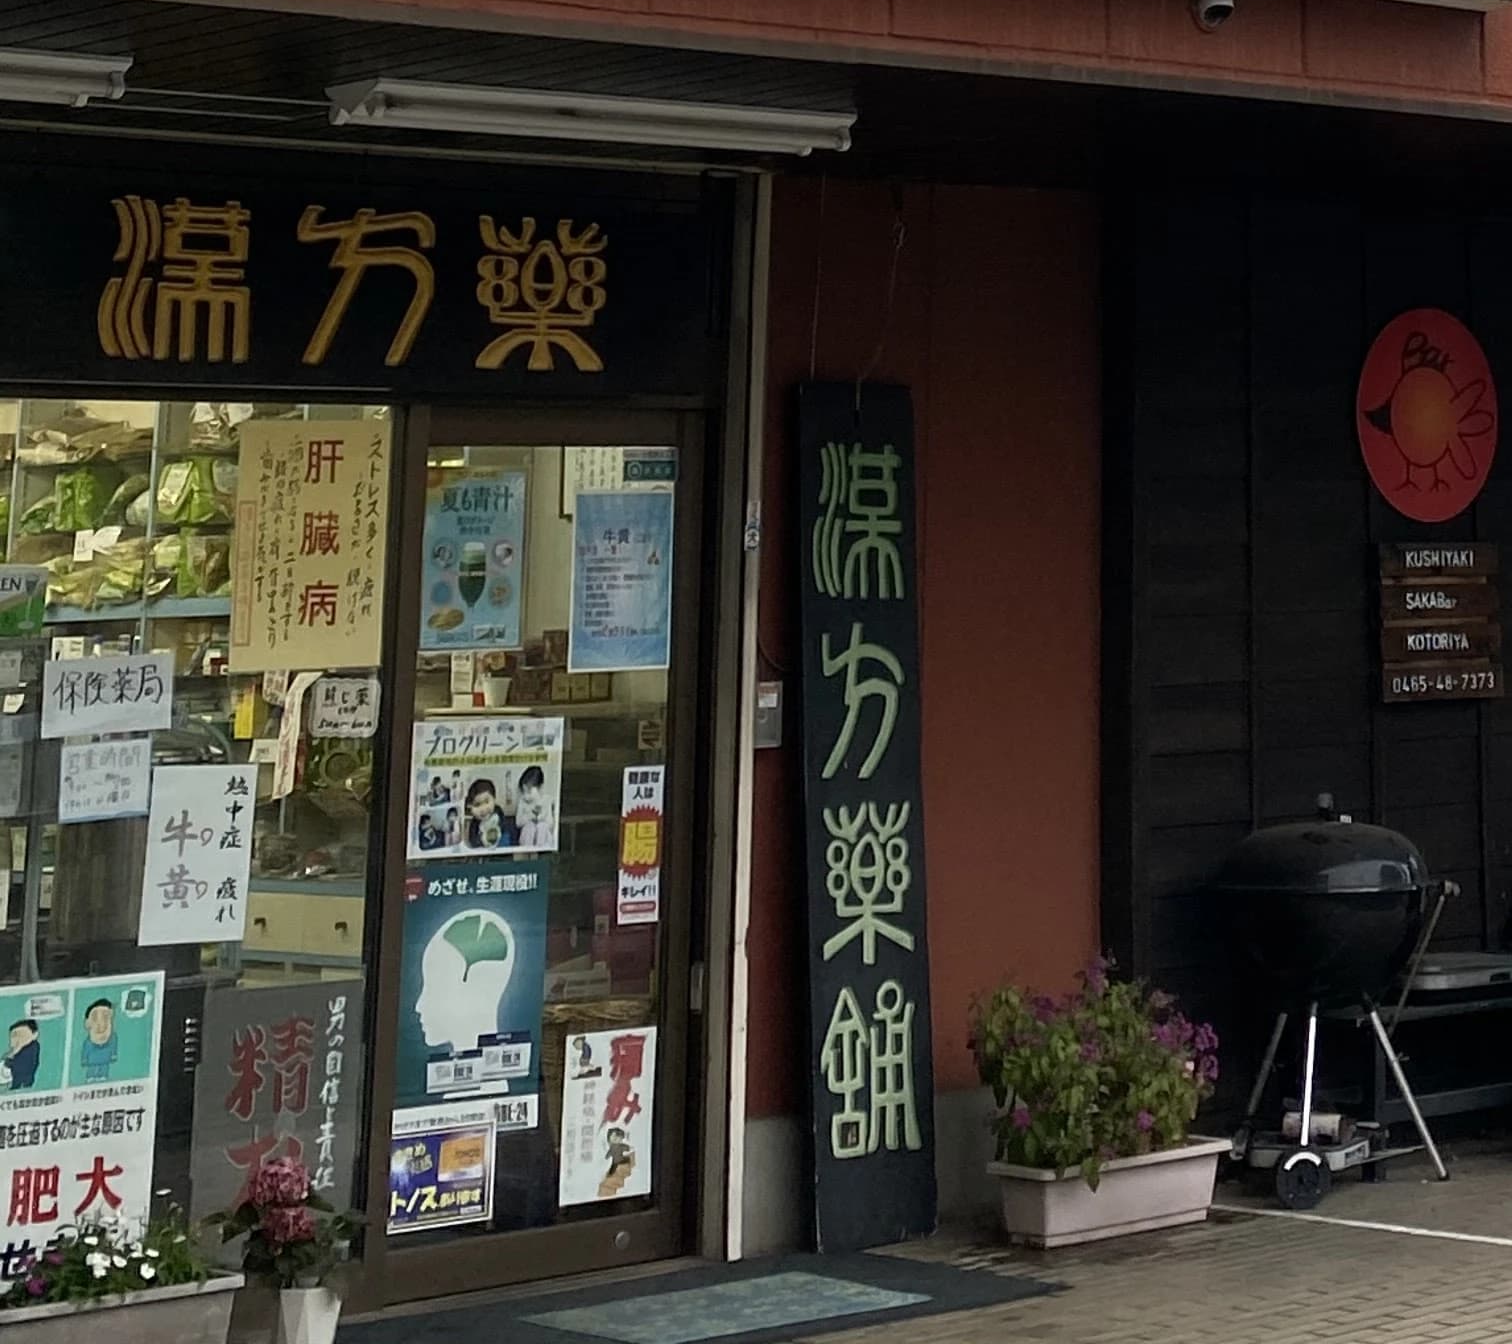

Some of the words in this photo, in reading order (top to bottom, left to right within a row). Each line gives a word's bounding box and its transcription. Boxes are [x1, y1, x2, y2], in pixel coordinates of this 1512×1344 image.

[298, 439, 345, 627] 肝臓病
[1405, 549, 1475, 569] KUSHIYAKI
[1406, 633, 1471, 653] KOTORIYA
[53, 664, 164, 714] 保険薬局
[1392, 672, 1496, 694] 0465-48-7373
